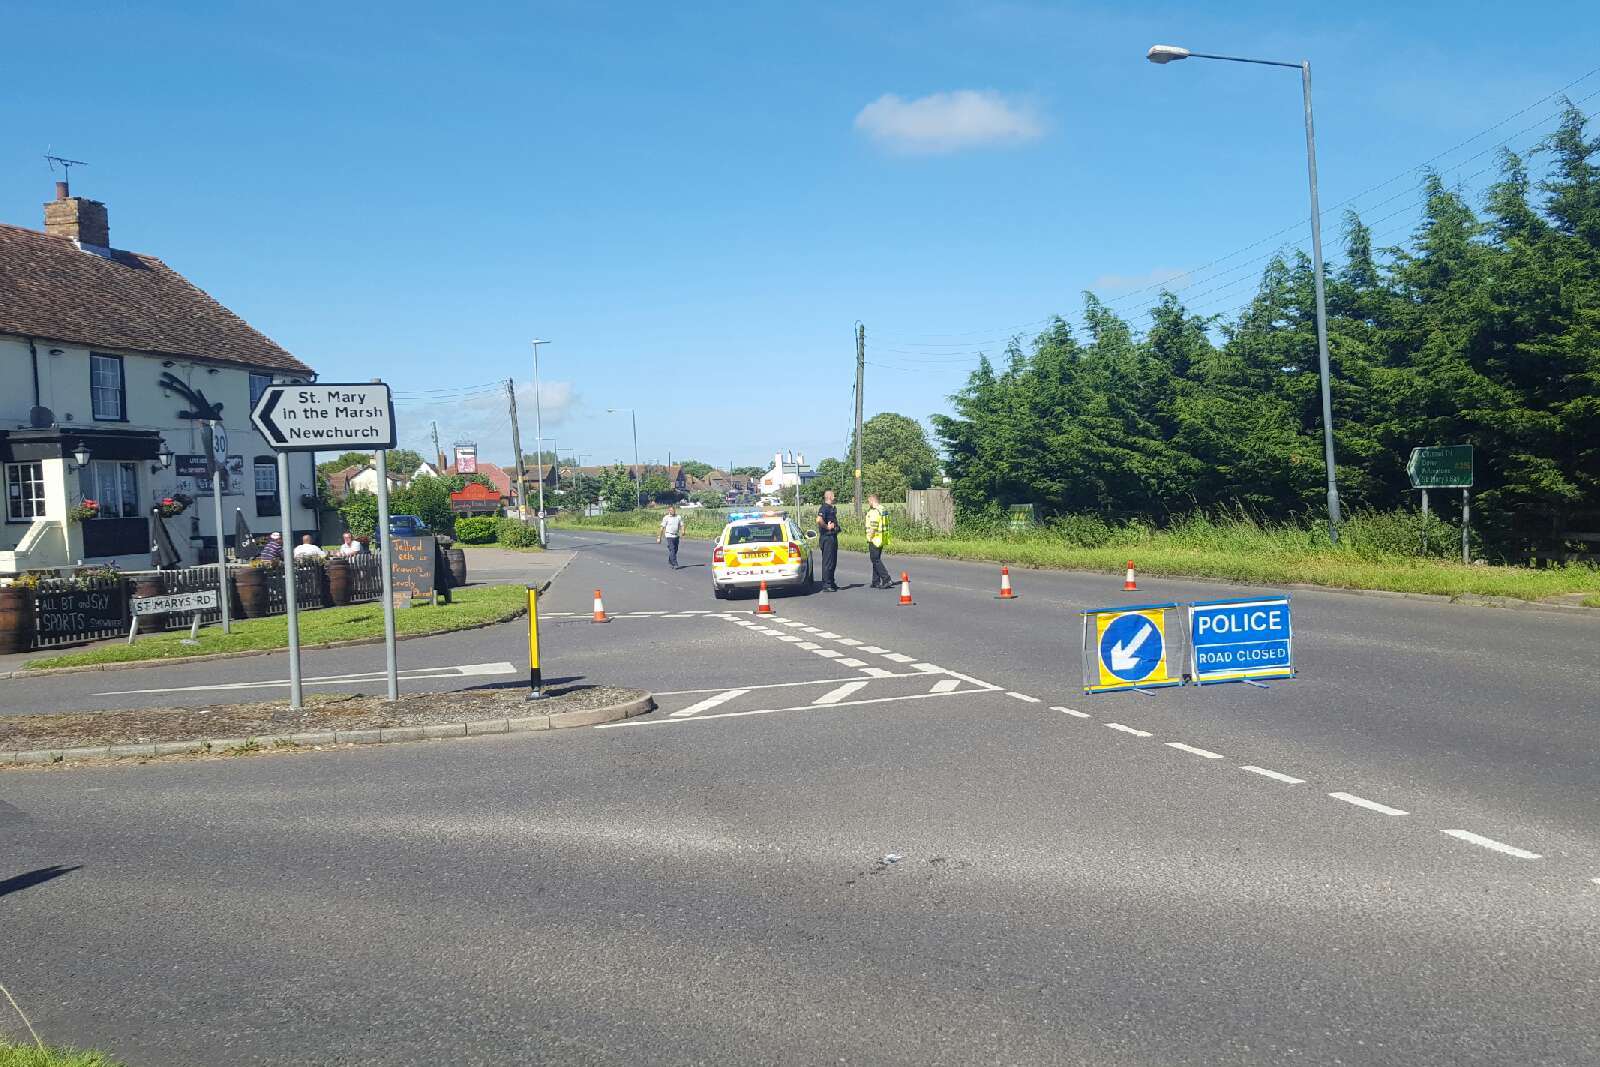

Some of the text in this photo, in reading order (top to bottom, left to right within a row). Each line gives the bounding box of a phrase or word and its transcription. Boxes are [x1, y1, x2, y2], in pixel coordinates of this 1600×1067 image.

[298, 391, 366, 405] St. Mary
[283, 405, 383, 420] in the Marsh
[290, 425, 379, 439] Newchurch
[214, 435, 226, 453] 30
[42, 597, 57, 610] ALL
[61, 595, 75, 610] BT
[136, 601, 151, 612] ST
[196, 595, 211, 605] RD
[43, 612, 86, 631] SPORTS
[1198, 610, 1282, 635] POLICE
[1199, 648, 1286, 664] ROAD CLOSED
